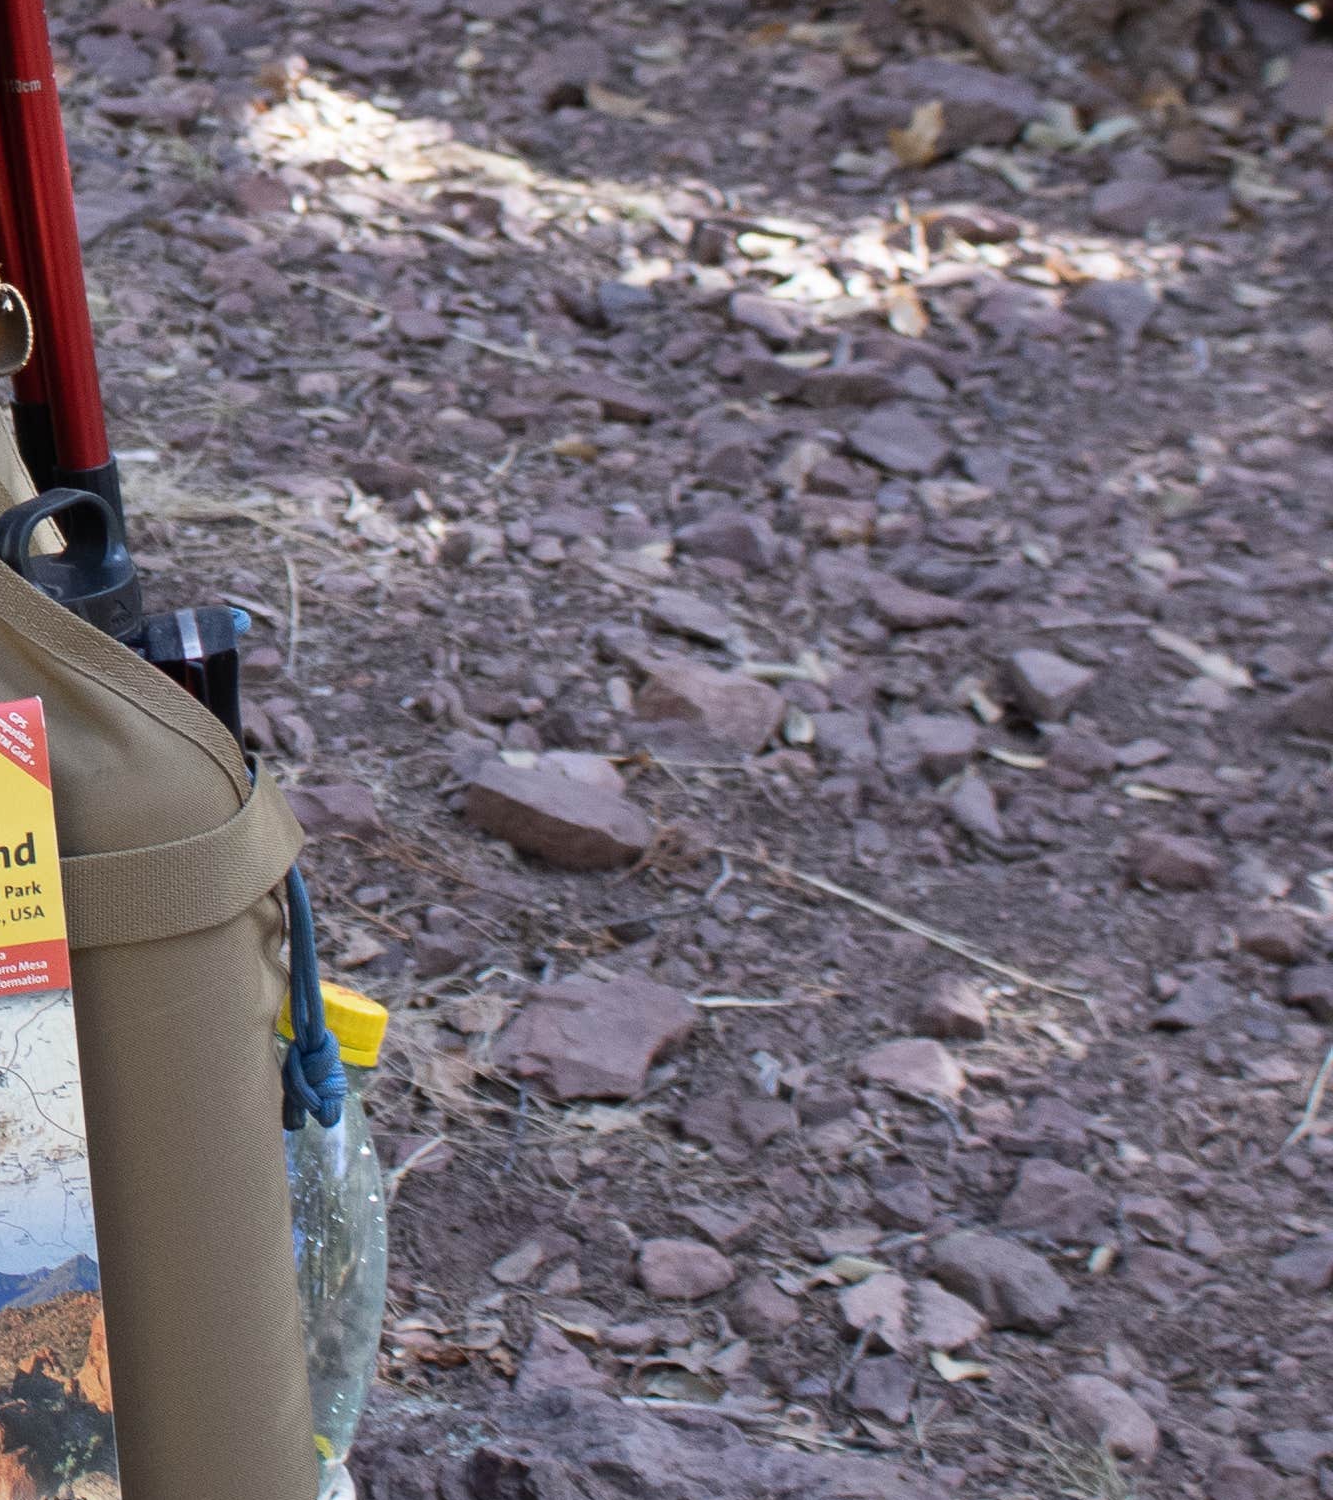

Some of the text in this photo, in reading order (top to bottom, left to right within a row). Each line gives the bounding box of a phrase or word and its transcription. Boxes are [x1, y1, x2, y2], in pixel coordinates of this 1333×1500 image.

[8, 711, 29, 730] GPS
[4, 881, 43, 899] Park
[10, 905, 45, 922] USA
[18, 959, 48, 971] Mesa
